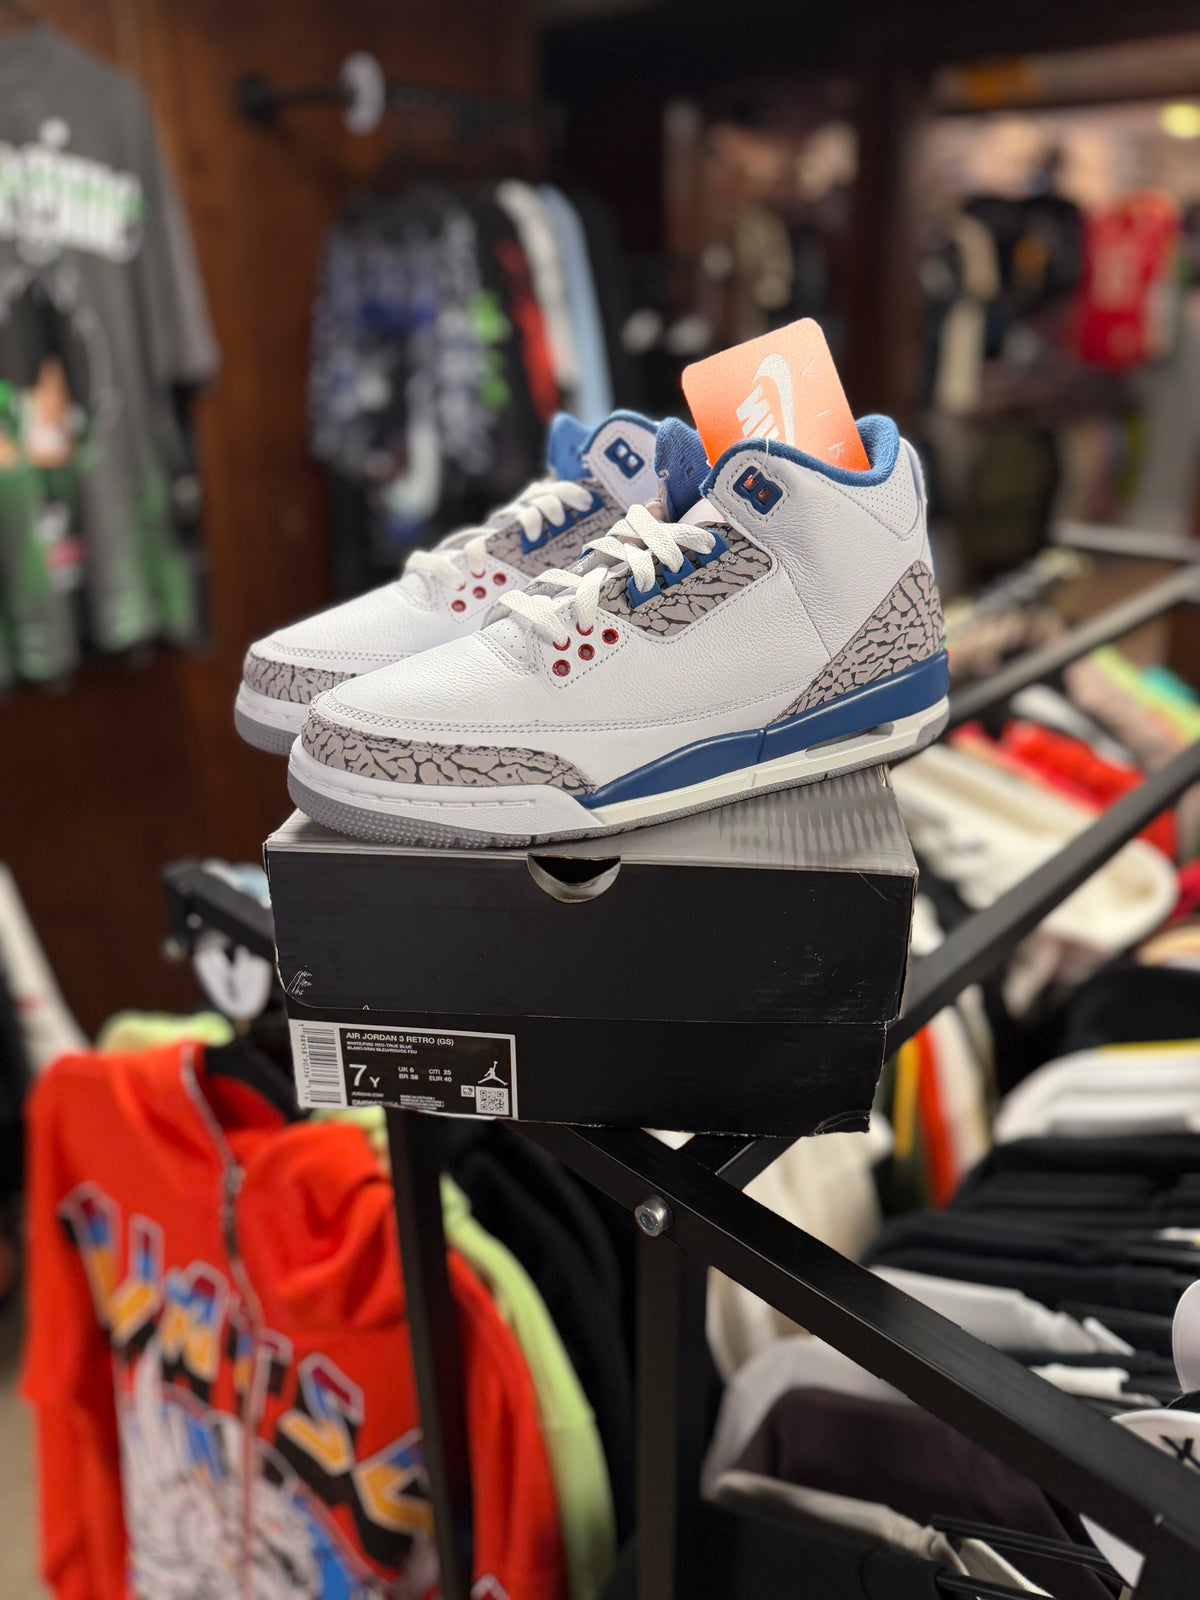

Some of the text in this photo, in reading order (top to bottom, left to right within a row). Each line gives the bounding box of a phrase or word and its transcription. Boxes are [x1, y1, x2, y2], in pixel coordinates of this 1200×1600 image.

[346, 1032, 361, 1040] AIR
[362, 1033, 397, 1042] JORDAN
[406, 1036, 435, 1044] RETRO
[437, 1038, 454, 1047] (GS)
[349, 1064, 380, 1088] 7 Y
